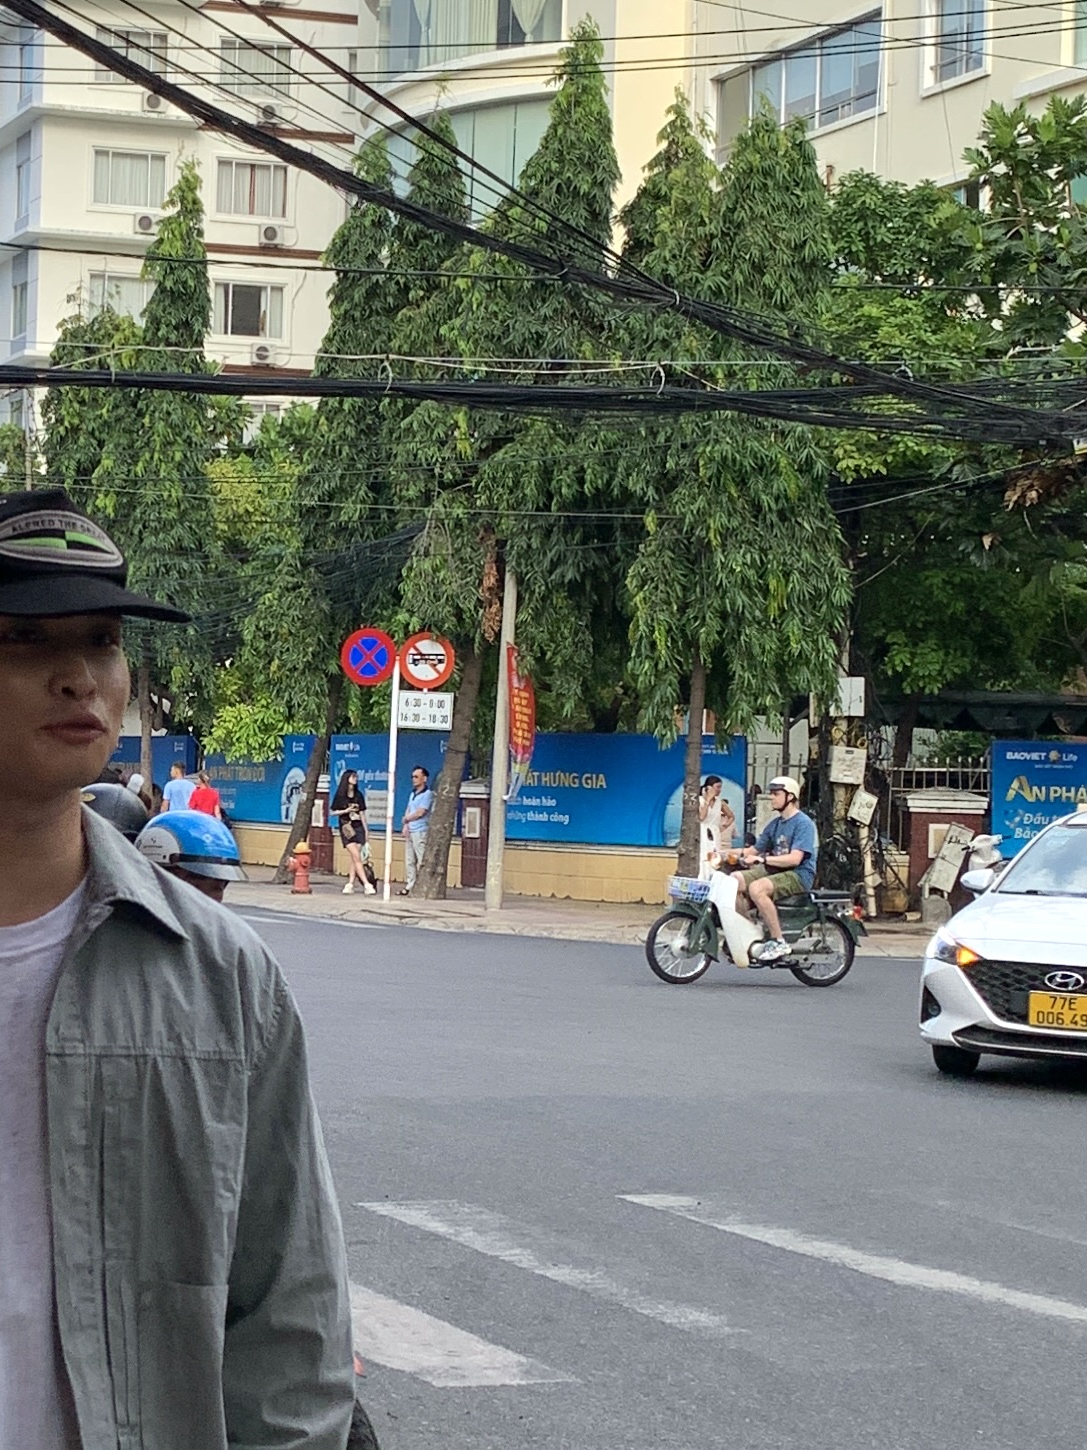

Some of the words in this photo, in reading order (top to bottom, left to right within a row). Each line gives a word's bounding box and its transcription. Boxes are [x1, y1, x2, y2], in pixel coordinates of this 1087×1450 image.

[12, 520, 55, 532] ALFRED
[58, 519, 77, 530] THE
[1062, 753, 1078, 762] Life
[541, 770, 580, 788] HƯNG
[581, 773, 608, 789] GIA
[1005, 775, 1046, 803] AN
[1049, 995, 1078, 1011] 77E
[1036, 1010, 1087, 1028] 006.49
